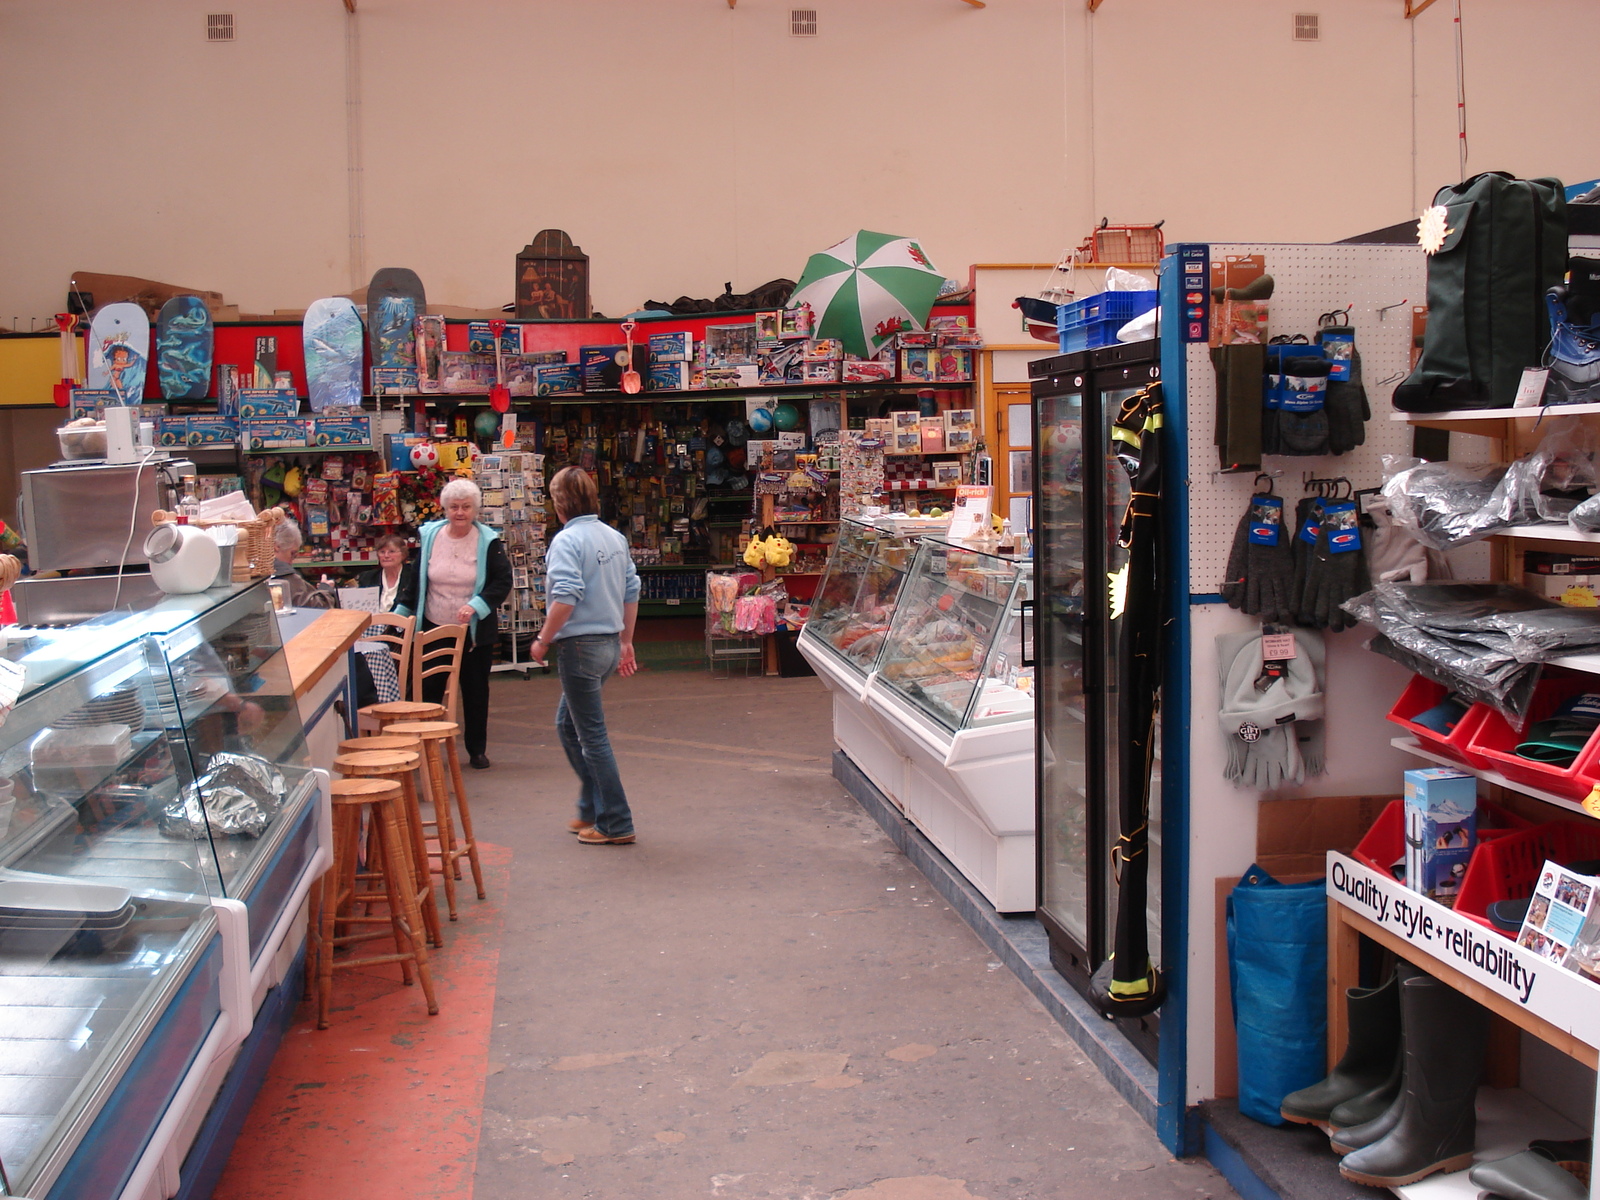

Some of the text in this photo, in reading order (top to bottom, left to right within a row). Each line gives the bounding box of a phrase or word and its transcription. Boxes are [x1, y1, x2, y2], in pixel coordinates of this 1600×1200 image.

[1240, 726, 1258, 734] GIFT
[1332, 862, 1536, 1004] Quality, style + reliability
